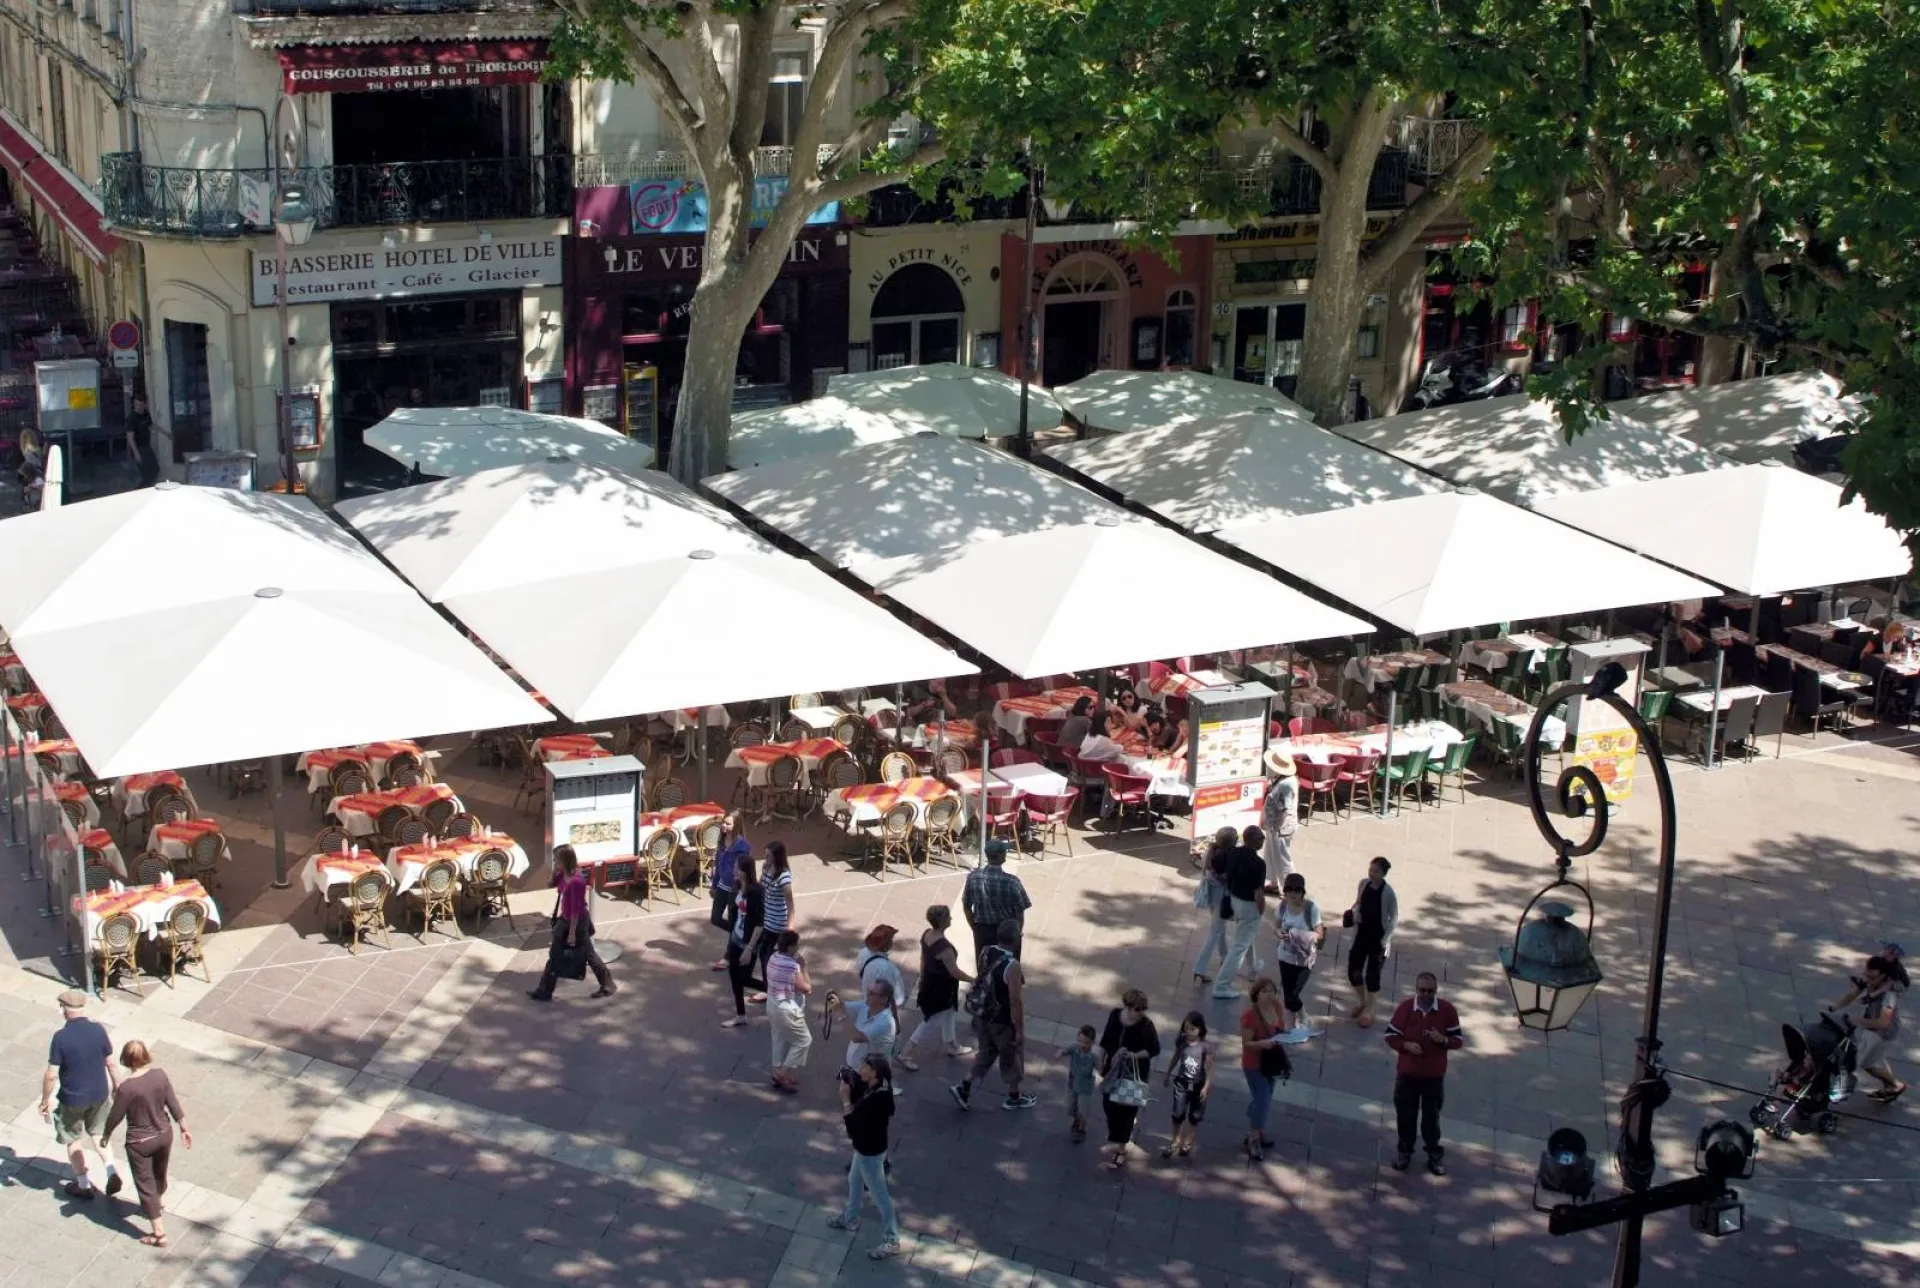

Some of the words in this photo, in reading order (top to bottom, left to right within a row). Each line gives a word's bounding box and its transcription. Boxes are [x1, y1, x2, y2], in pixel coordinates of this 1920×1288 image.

[385, 249, 458, 268] HOTEL
[463, 246, 492, 262] DE
[496, 241, 555, 259] VILLE
[605, 249, 643, 272] LE
[402, 271, 443, 288] Café
[467, 267, 540, 282] Glacier
[867, 269, 884, 294] AU
[887, 248, 936, 270] PETIT
[941, 252, 973, 286] NICE
